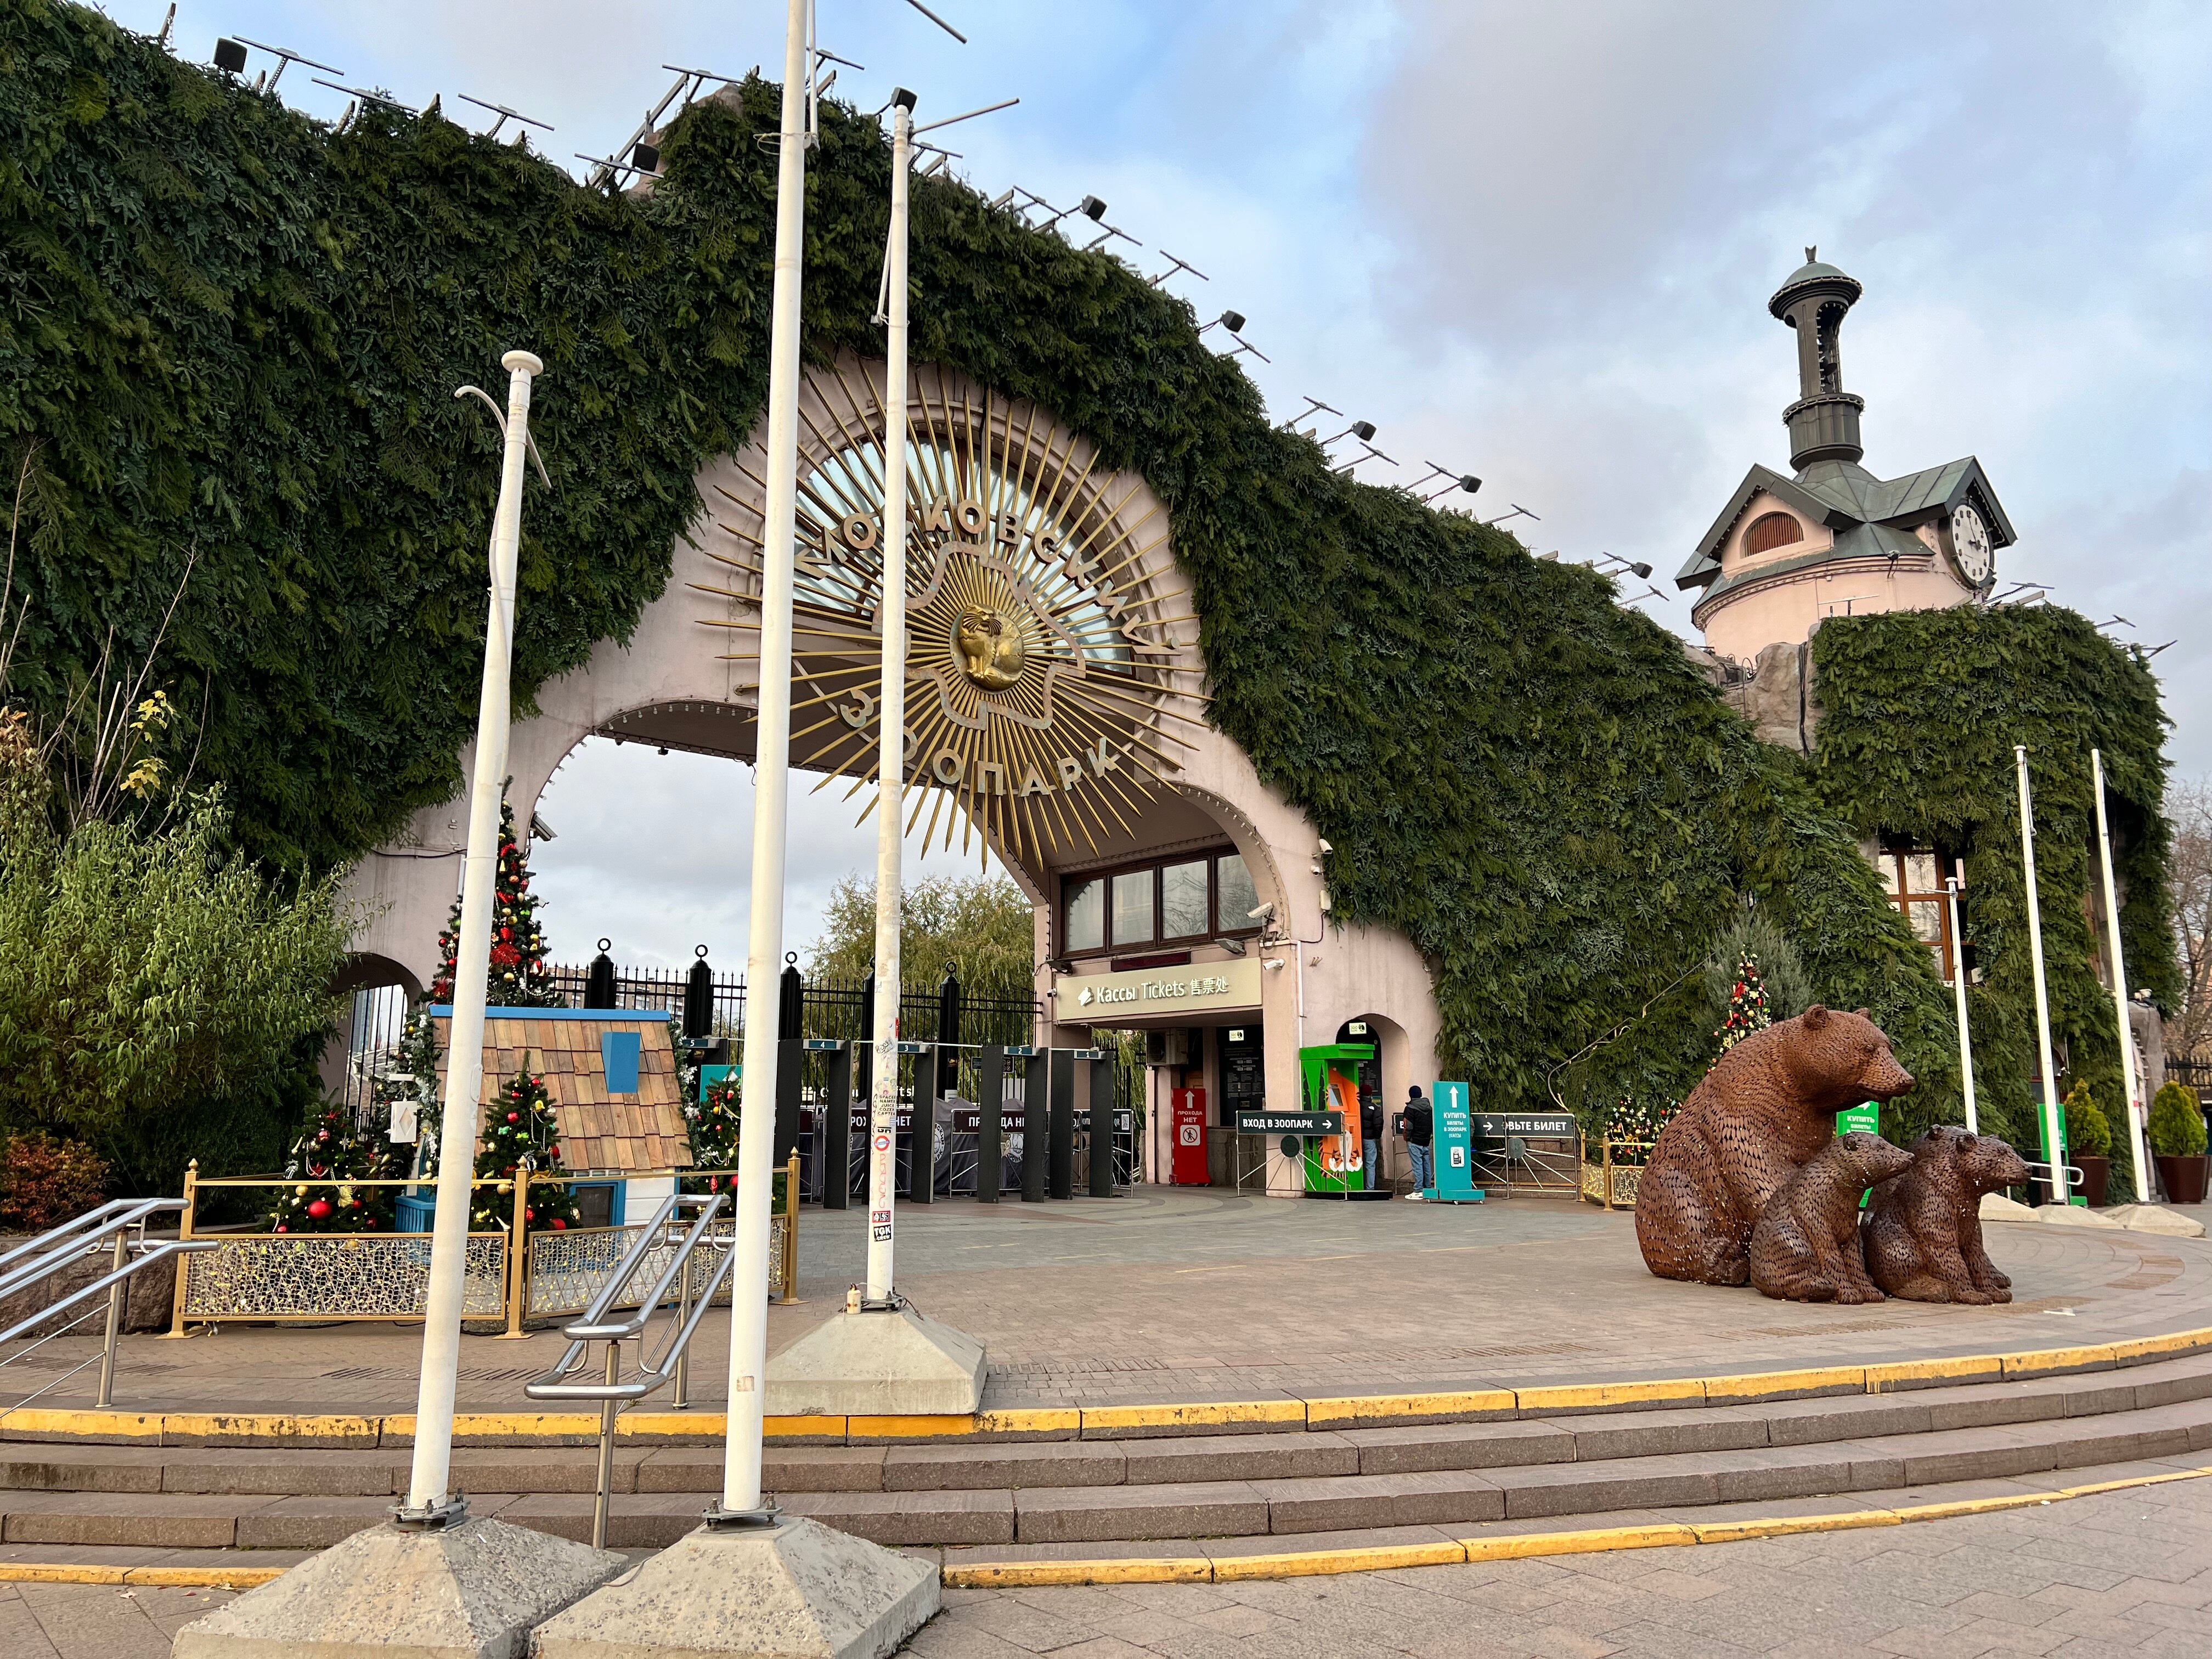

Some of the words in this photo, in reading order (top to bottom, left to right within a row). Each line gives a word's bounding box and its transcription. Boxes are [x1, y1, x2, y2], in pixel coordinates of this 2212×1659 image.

[794, 495, 1183, 656] МОКОВСКИЙ
[1097, 986, 1137, 1003] Кассы
[1141, 980, 1185, 1000] Tickets
[1189, 975, 1229, 996] 售票处
[1243, 1119, 1266, 1130] ВХОД
[1267, 1119, 1273, 1127] В
[1274, 1119, 1313, 1128] ЗООПАРК
[1534, 1121, 1567, 1131] БИЛЕТ
